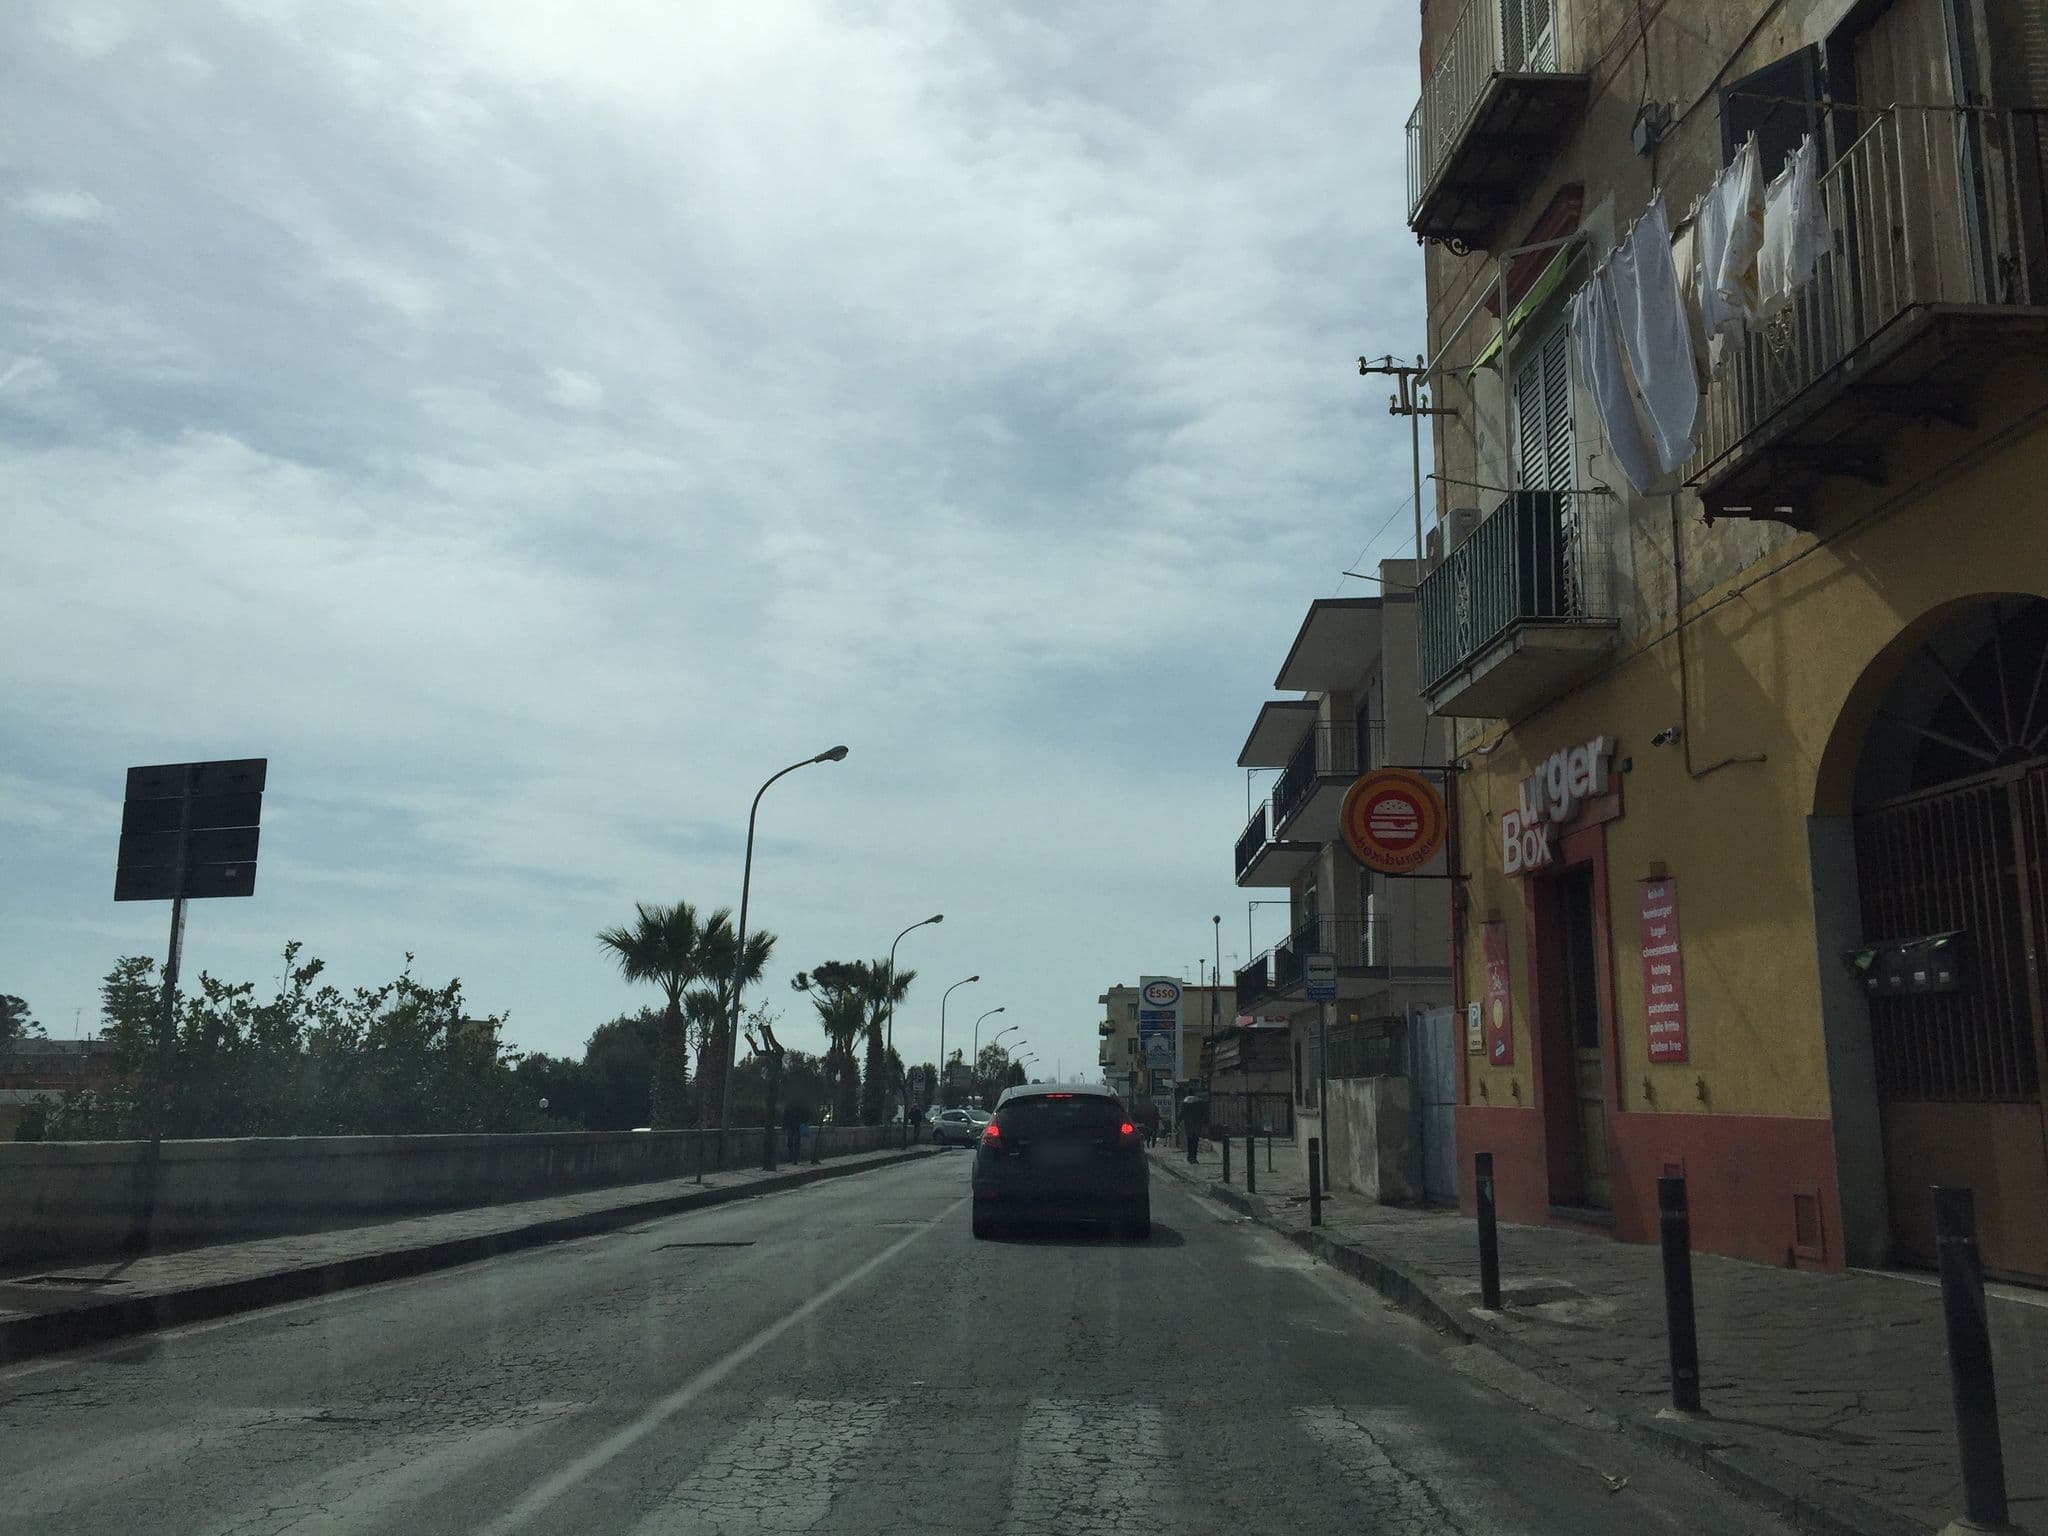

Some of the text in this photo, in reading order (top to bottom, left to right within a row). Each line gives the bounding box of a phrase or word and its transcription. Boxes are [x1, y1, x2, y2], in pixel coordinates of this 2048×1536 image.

[1502, 810, 1553, 875] Box
[1643, 907, 1672, 919] hamburger
[1669, 1040, 1682, 1051] free
